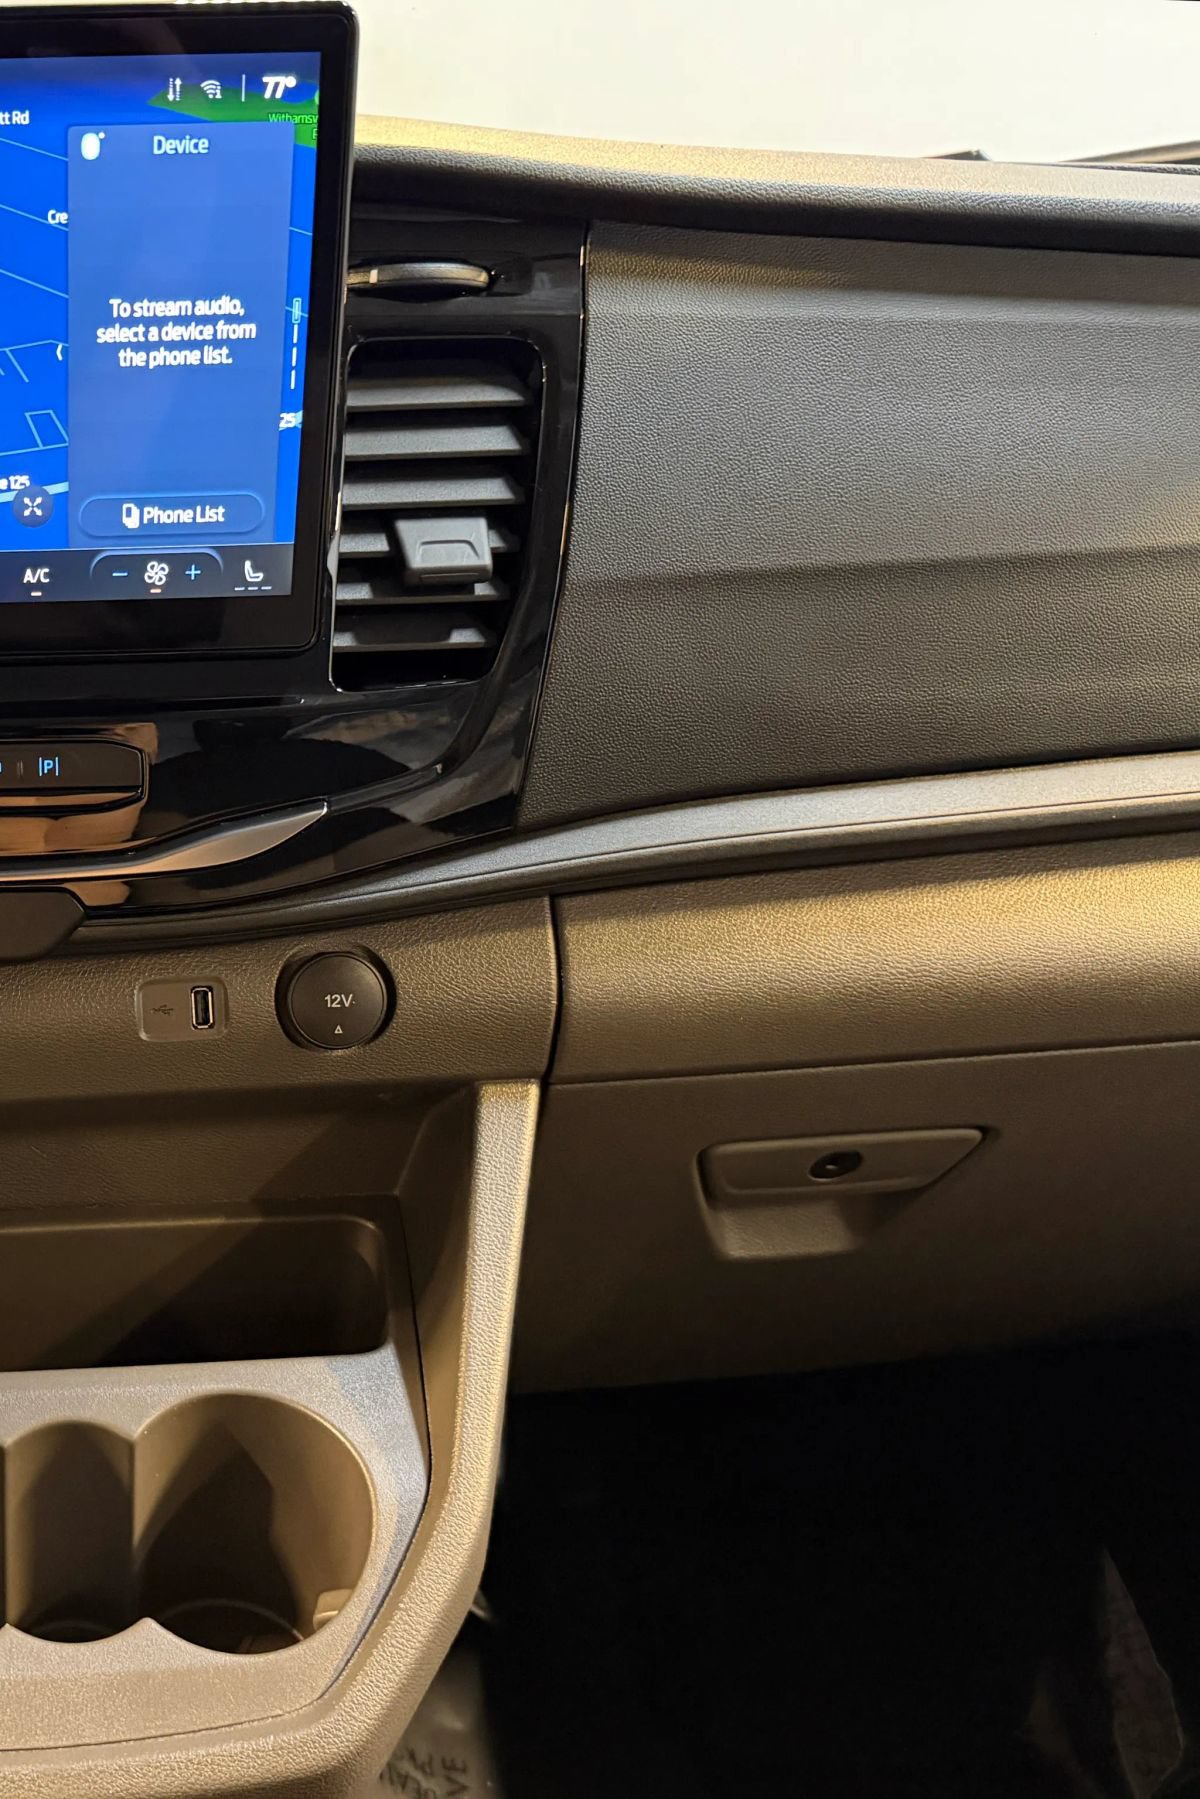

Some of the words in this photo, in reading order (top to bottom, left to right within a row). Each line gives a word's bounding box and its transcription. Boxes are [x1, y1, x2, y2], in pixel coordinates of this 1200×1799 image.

[12, 110, 30, 125] Rd
[153, 135, 209, 155] Device
[109, 298, 132, 318] To
[133, 299, 192, 317] stream
[194, 296, 244, 317] audio,
[96, 324, 146, 344] select
[148, 327, 159, 342] a
[161, 322, 213, 342] device
[216, 321, 256, 340] from
[118, 348, 147, 368] the
[149, 347, 201, 369] phone
[202, 346, 232, 365] list.
[9, 475, 30, 488] 125
[143, 507, 194, 525] Phone
[195, 505, 225, 522] List
[23, 568, 50, 584] A/C
[324, 993, 353, 1008] 12V
